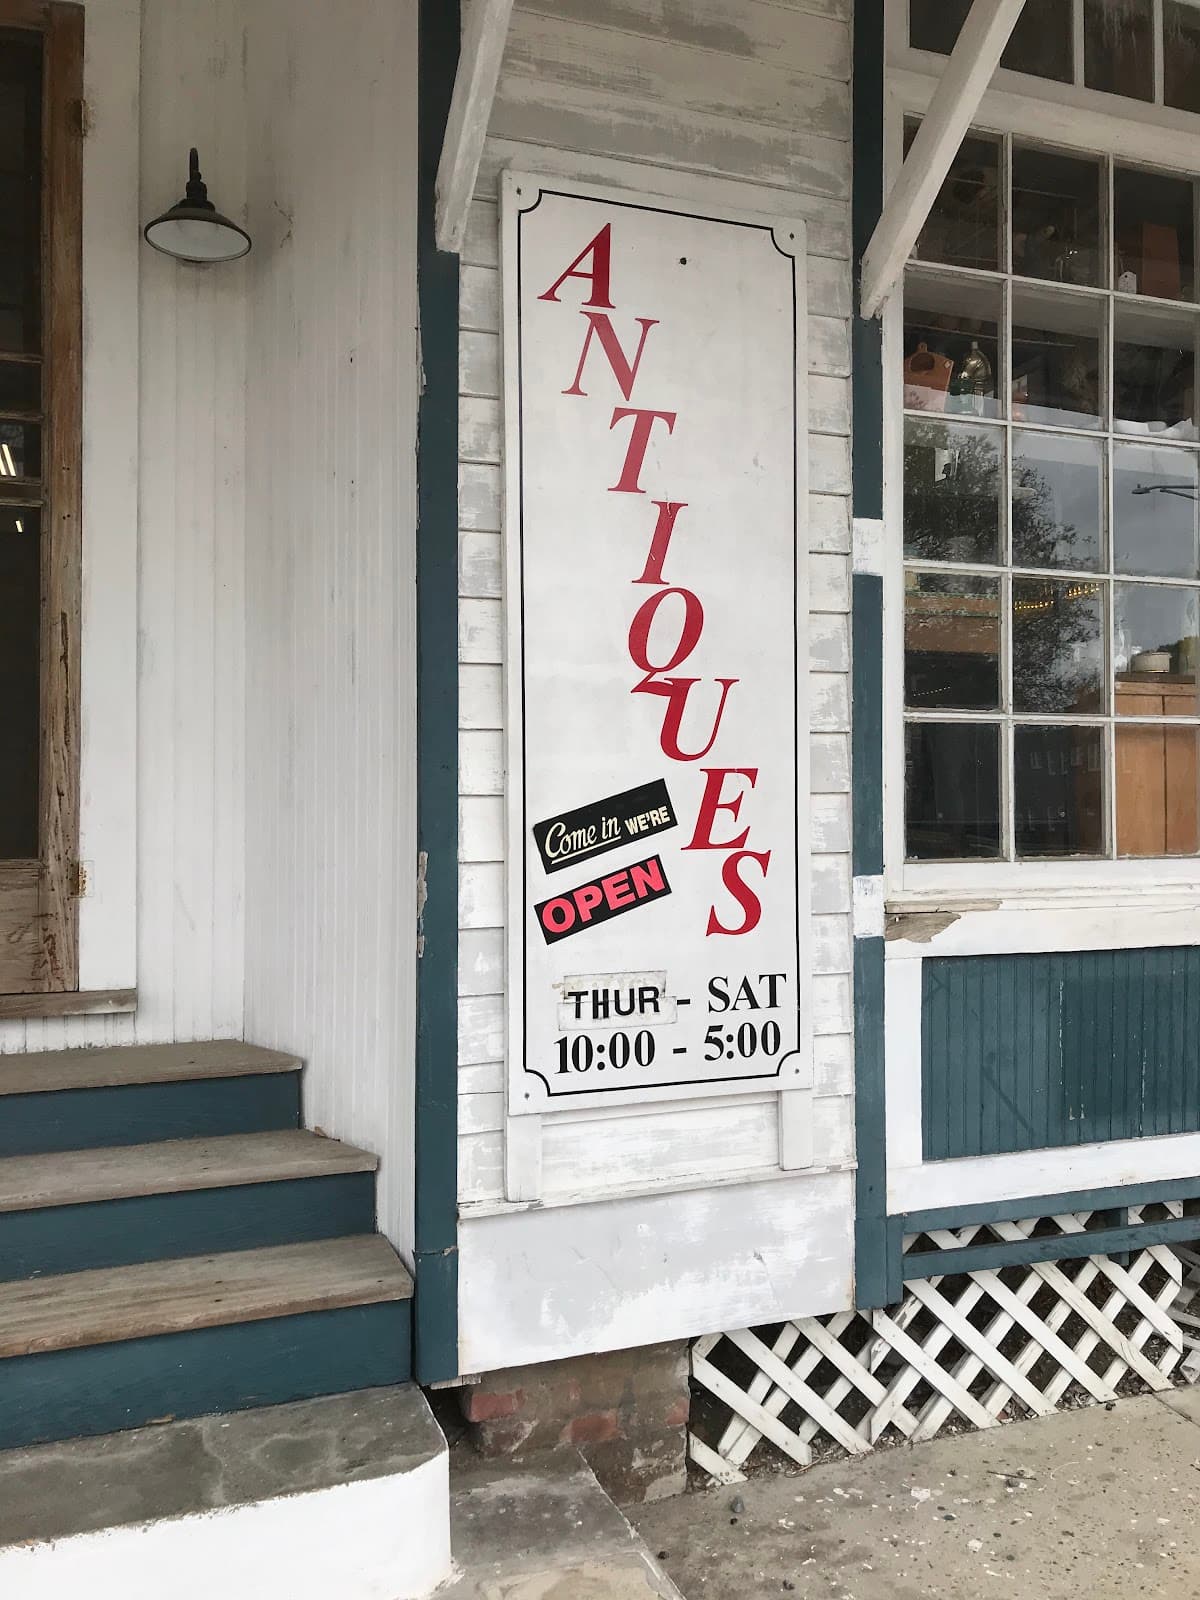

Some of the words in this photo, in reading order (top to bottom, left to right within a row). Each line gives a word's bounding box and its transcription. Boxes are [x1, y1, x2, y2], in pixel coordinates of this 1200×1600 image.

[537, 222, 771, 937] ANTIQUES
[544, 821, 598, 858] Come
[601, 815, 621, 839] in
[624, 805, 671, 836] WE'RE
[542, 858, 666, 934] OPEN
[567, 986, 660, 1020] THUR
[707, 973, 787, 1014] SAT
[553, 1029, 656, 1075] 10:00
[703, 1020, 781, 1062] 5:00
